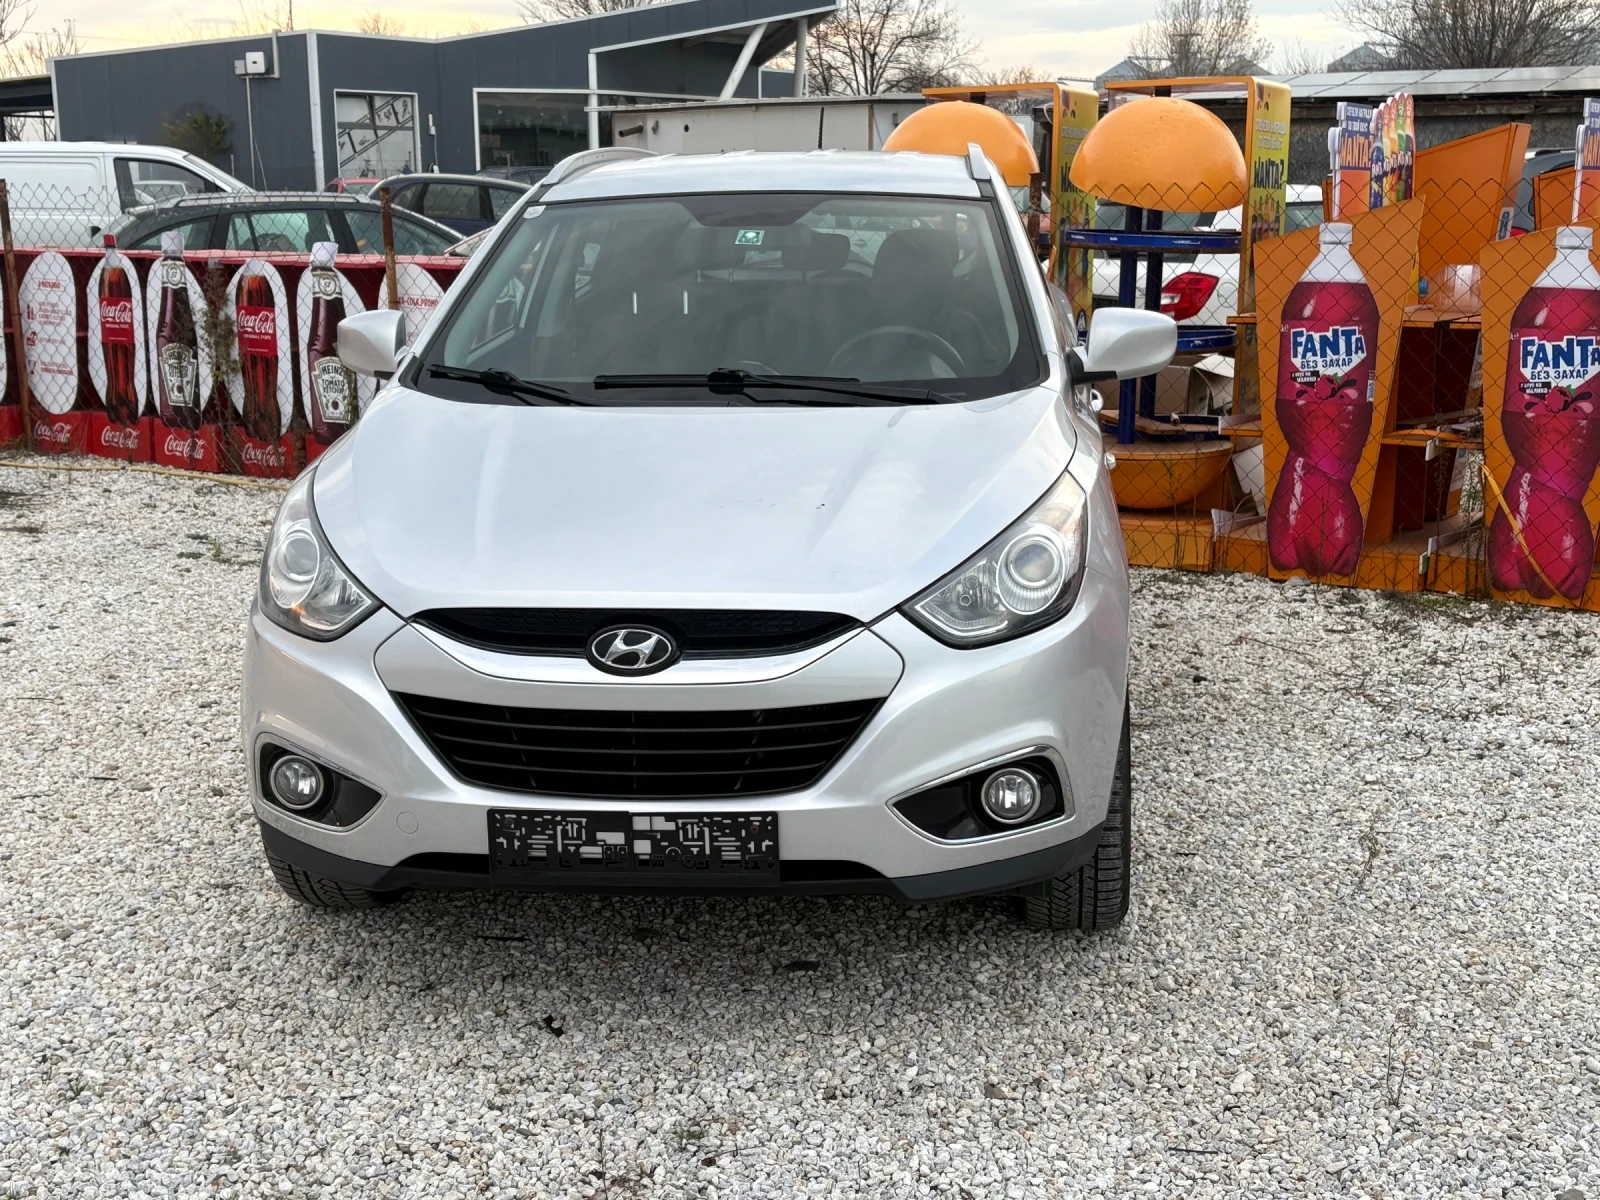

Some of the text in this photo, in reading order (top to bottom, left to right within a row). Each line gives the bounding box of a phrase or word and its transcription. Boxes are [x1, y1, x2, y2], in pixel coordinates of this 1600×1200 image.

[101, 301, 132, 323] Coca-Cola
[238, 309, 275, 334] Coca-Cola
[1291, 328, 1365, 360] FANTA
[1521, 337, 1600, 370] FANTA
[321, 364, 343, 376] HEINZ
[1300, 357, 1353, 370] БЕЗ ЗАХАР
[1530, 369, 1589, 380] БЕЗ ЗАХАР
[321, 378, 346, 388] TOMATO
[34, 420, 71, 443] Coca-Cola
[101, 425, 140, 450] Coca-Cola
